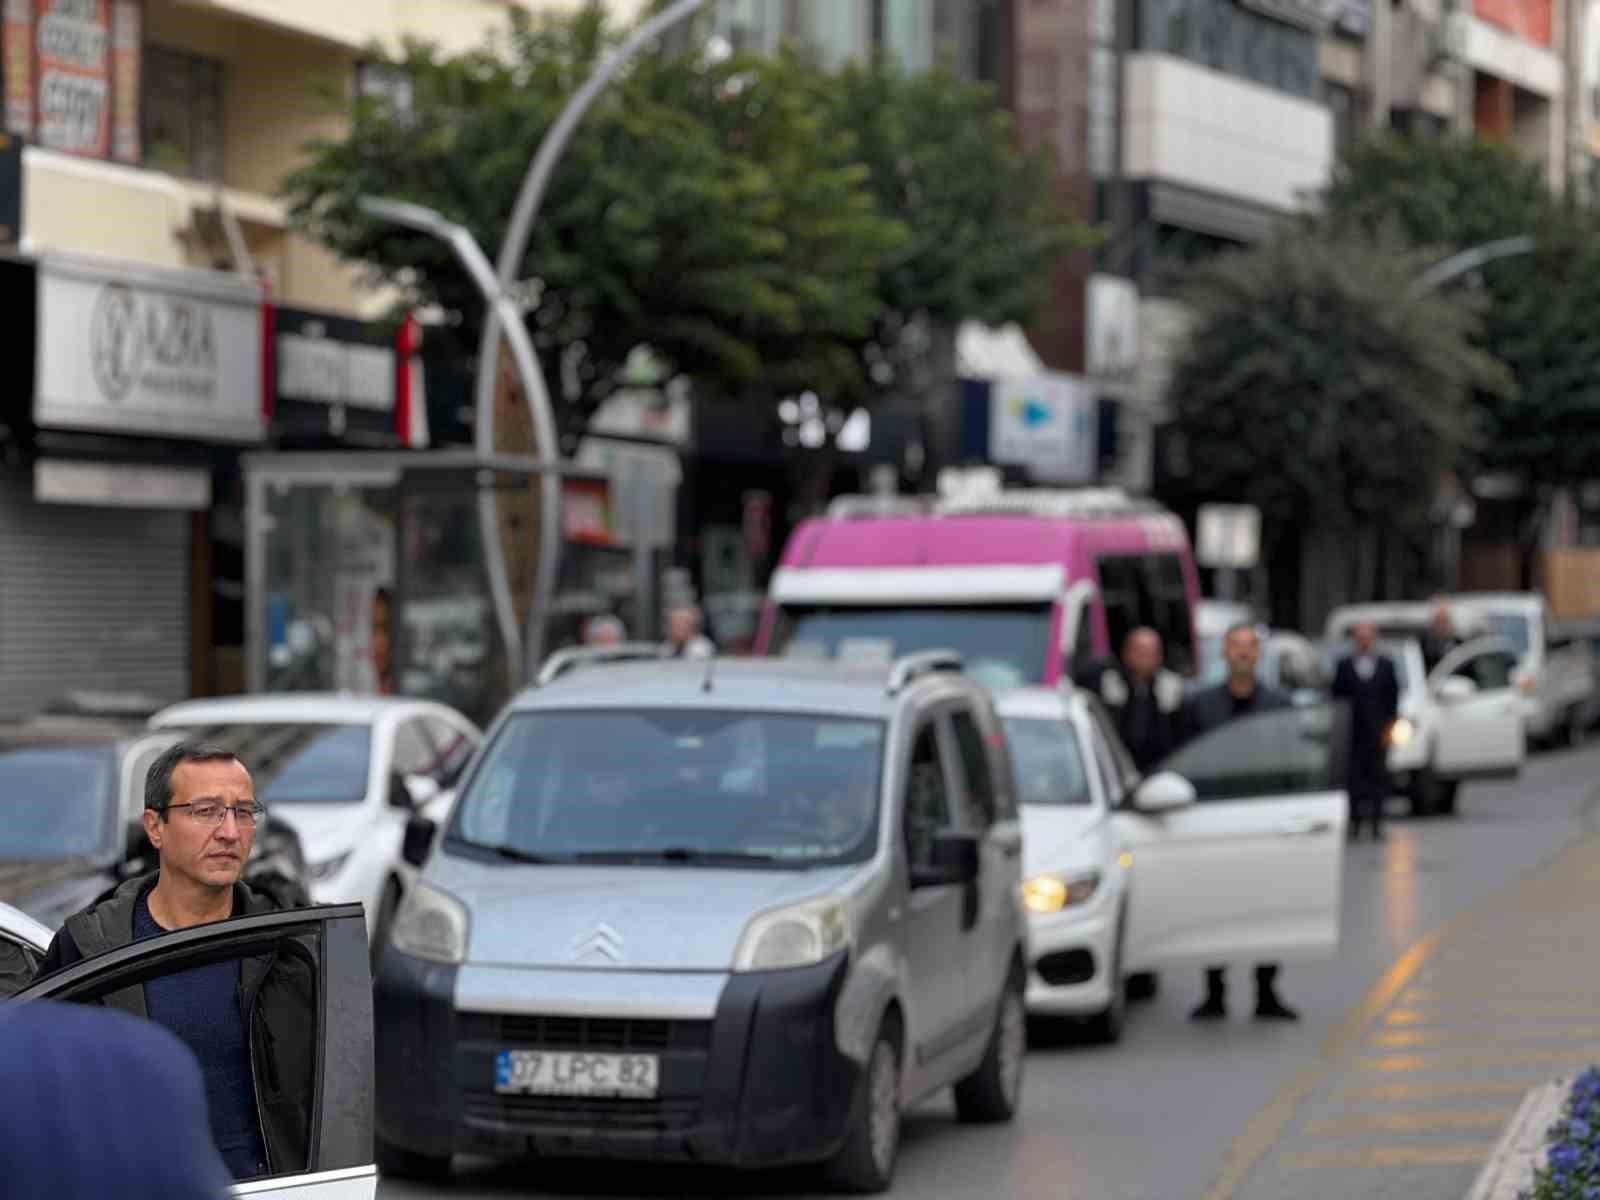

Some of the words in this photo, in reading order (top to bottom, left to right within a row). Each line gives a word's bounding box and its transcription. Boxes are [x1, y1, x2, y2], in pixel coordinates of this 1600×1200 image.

[513, 1053, 542, 1081] 07
[551, 1054, 608, 1084] LPC
[618, 1055, 650, 1086] 82
